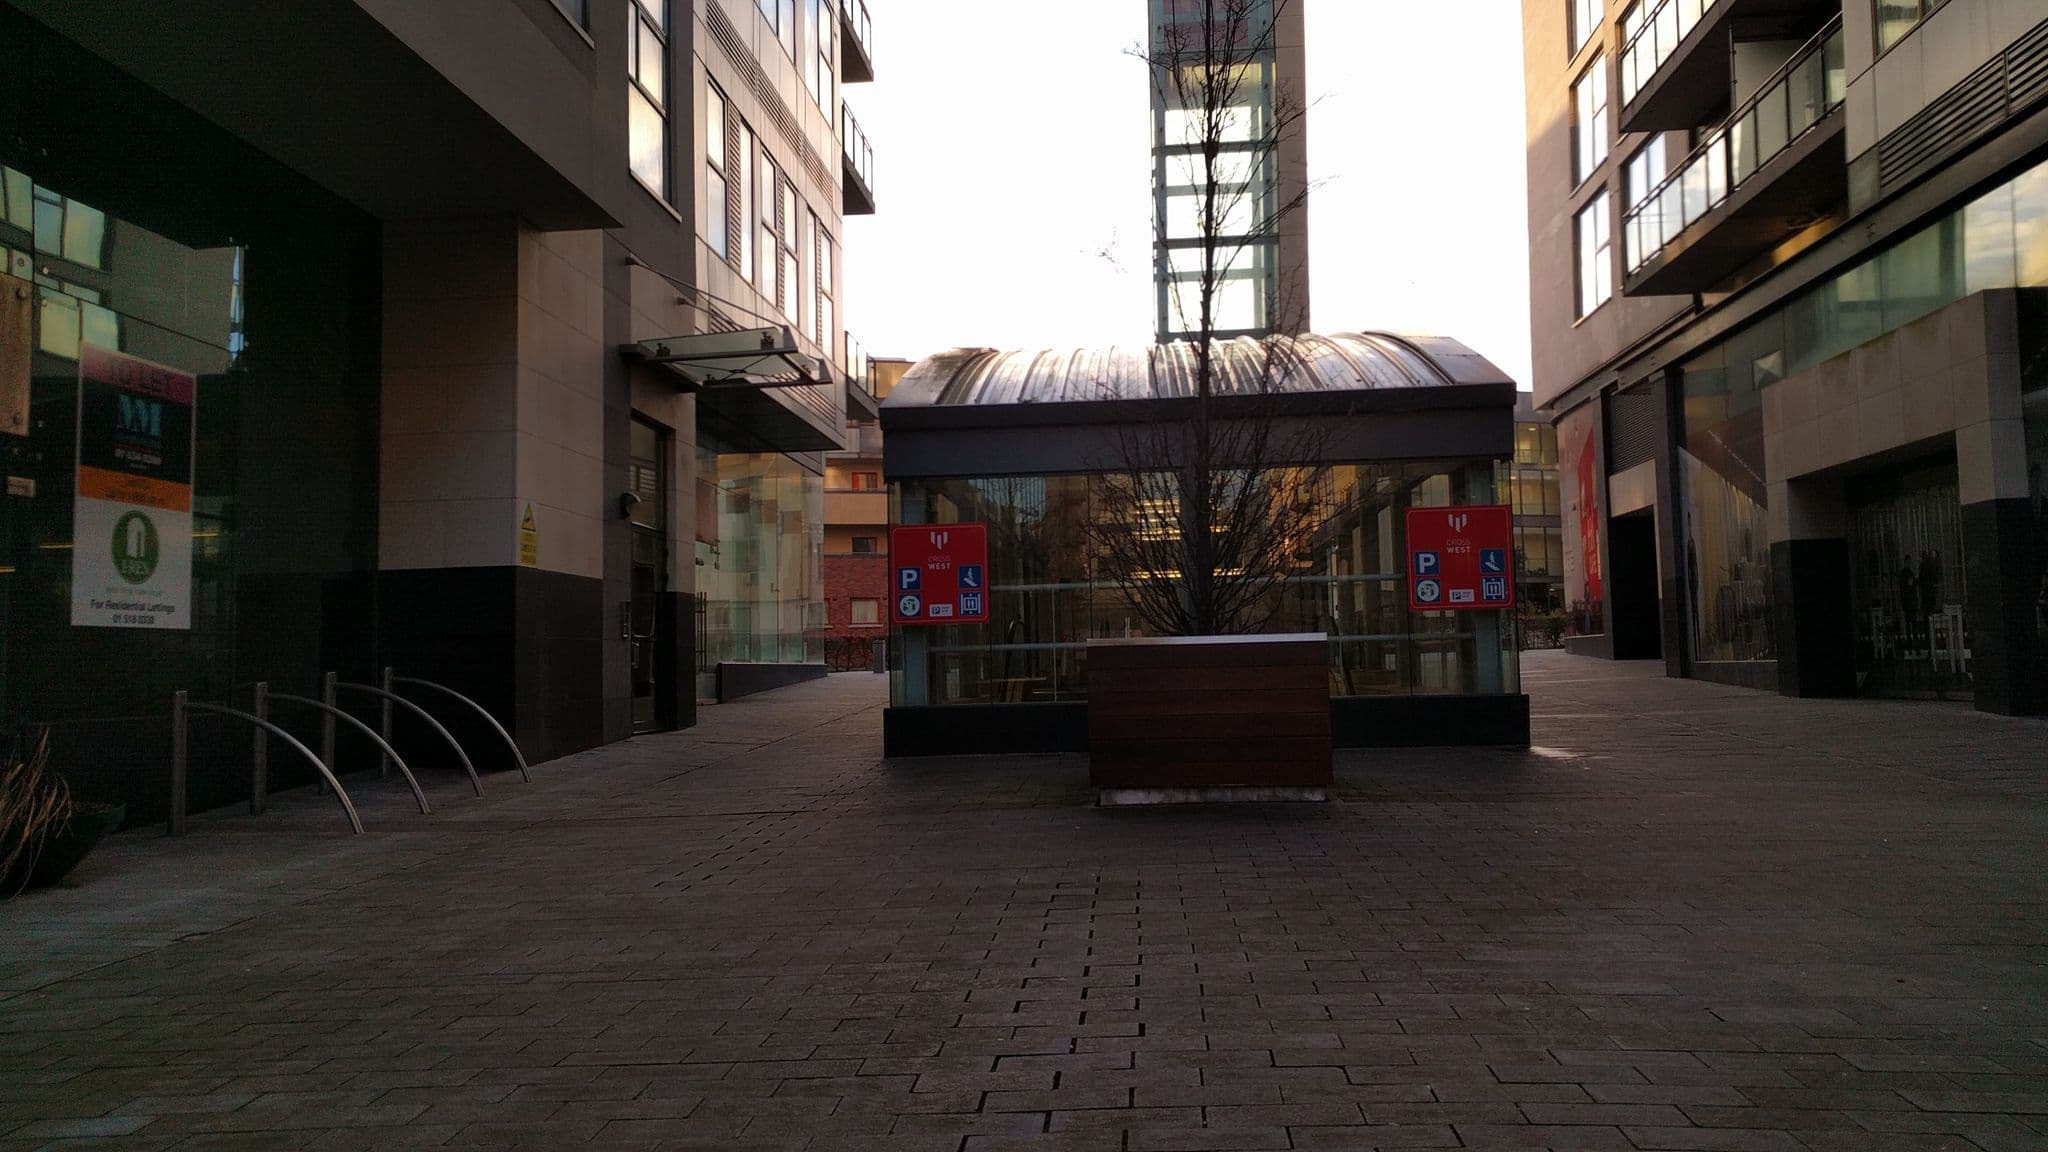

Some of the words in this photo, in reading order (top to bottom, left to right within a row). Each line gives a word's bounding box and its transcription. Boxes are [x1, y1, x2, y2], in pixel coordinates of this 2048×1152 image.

[1446, 538, 1472, 546] CROSS
[1446, 546, 1472, 554] WEST
[1418, 553, 1436, 574] P
[901, 569, 918, 590] P
[90, 599, 105, 609] For
[105, 600, 146, 611] Residential
[147, 602, 176, 615] Lettings
